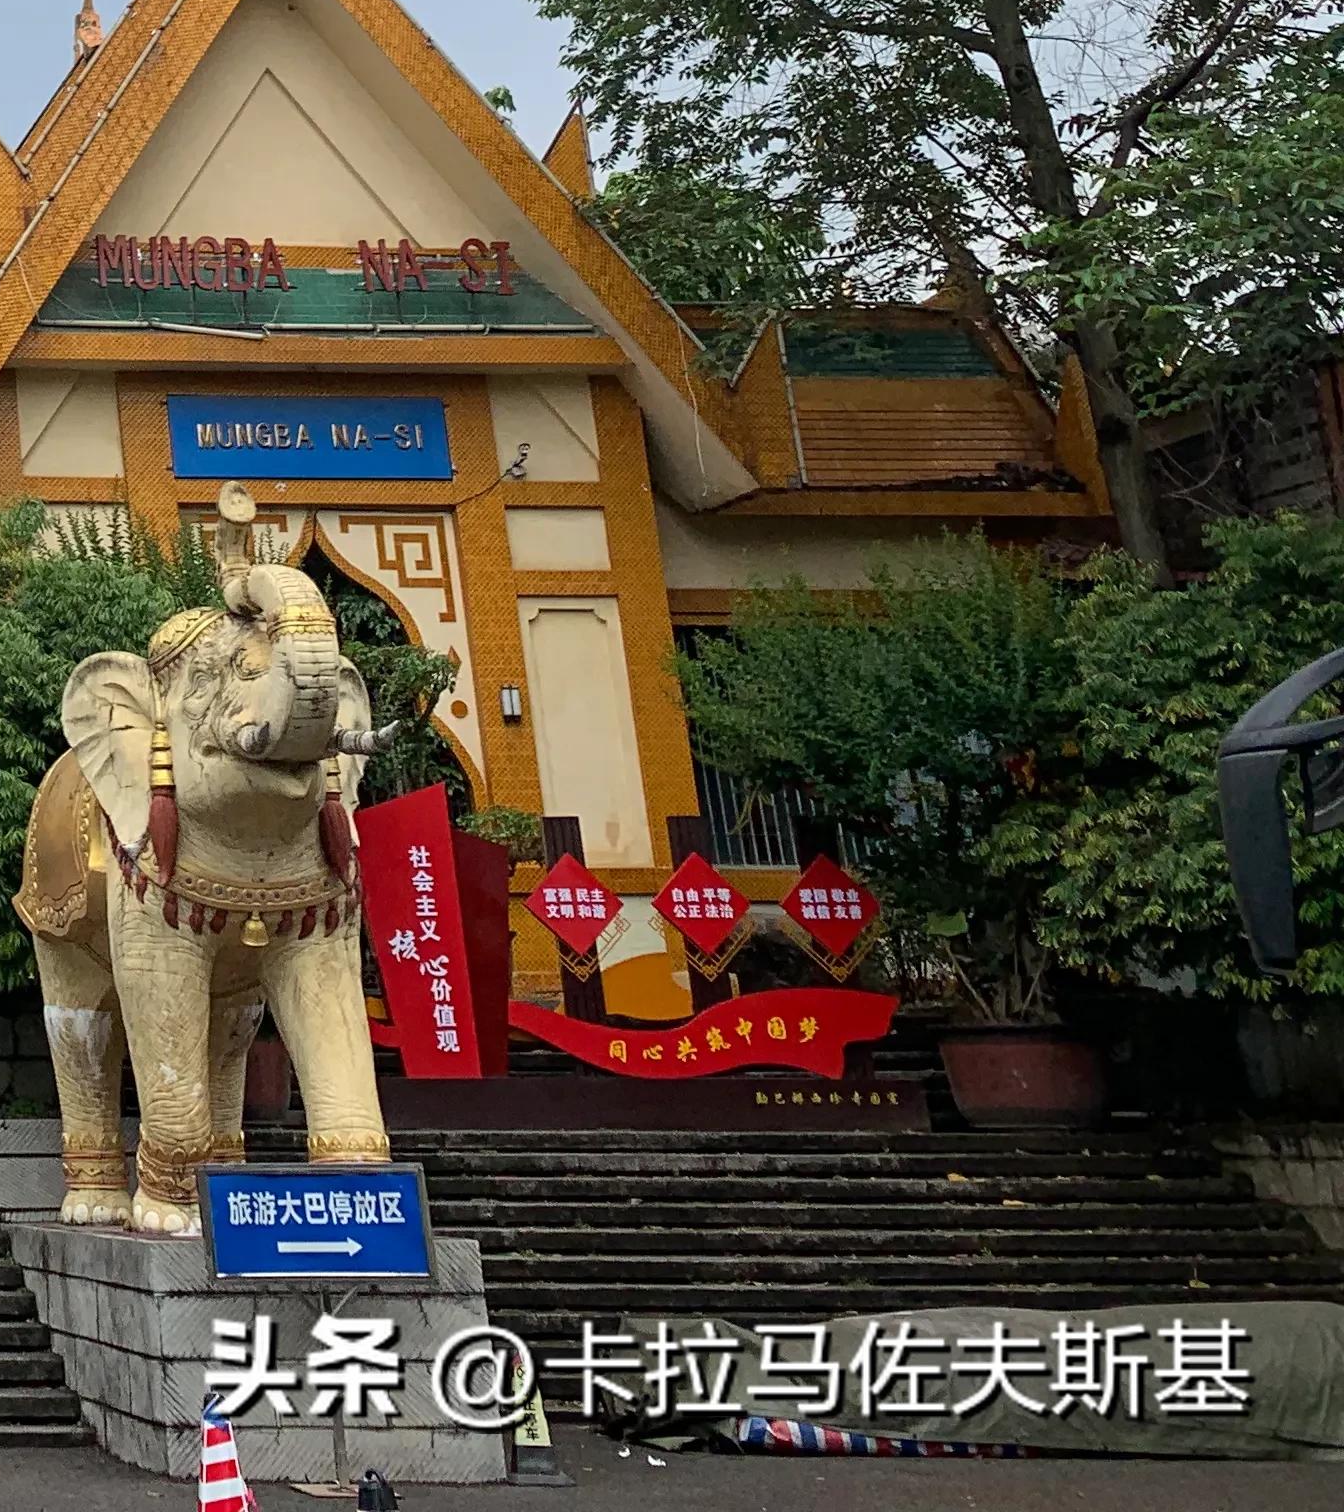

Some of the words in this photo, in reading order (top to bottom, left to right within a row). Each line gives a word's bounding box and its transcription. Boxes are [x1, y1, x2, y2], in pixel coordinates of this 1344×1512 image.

[95, 234, 290, 292] MUNGBA
[357, 238, 517, 296] NA-SI
[196, 422, 313, 450] MUNGBA
[331, 423, 425, 451] NA-SI
[408, 845, 441, 942] 社会主义
[543, 888, 573, 903] 富强
[576, 888, 606, 903] 民主
[671, 888, 700, 903] 自由
[703, 888, 732, 903] 平等
[799, 889, 828, 904] 爱国
[831, 889, 861, 904] 敬业
[546, 904, 575, 919] 文明
[578, 904, 607, 919] 和谐
[674, 904, 703, 919] 公正
[705, 904, 734, 919] 法治
[801, 905, 831, 920] 诚信
[834, 905, 862, 920] 友善
[388, 929, 461, 1053] 核心价值观
[609, 1016, 820, 1064] 同心共筑中国梦
[227, 1190, 406, 1226] 旅游大巴停放区
